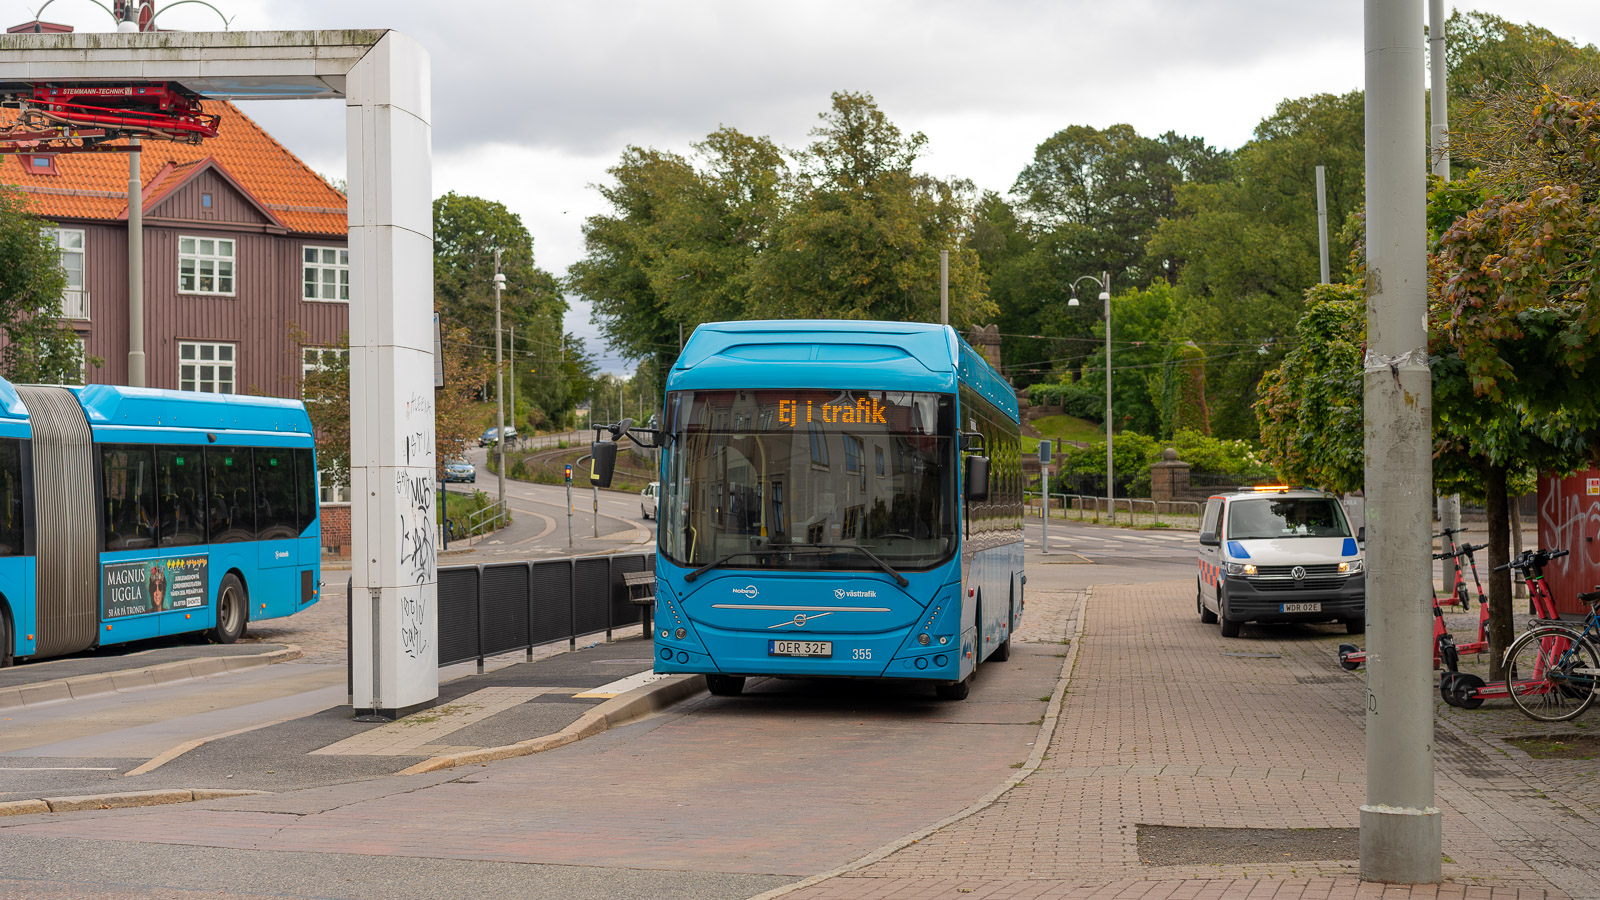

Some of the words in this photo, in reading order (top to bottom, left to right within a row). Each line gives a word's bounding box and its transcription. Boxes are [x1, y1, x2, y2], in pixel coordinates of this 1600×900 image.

[778, 399, 796, 427] Ej
[807, 399, 812, 423] i
[822, 397, 887, 424] trafik
[107, 568, 145, 585] MAGNUS
[112, 586, 142, 602] UGGLA
[127, 605, 145, 615] TRONEN
[778, 642, 801, 653] OER
[804, 643, 827, 654] 32F
[852, 648, 872, 660] 355
